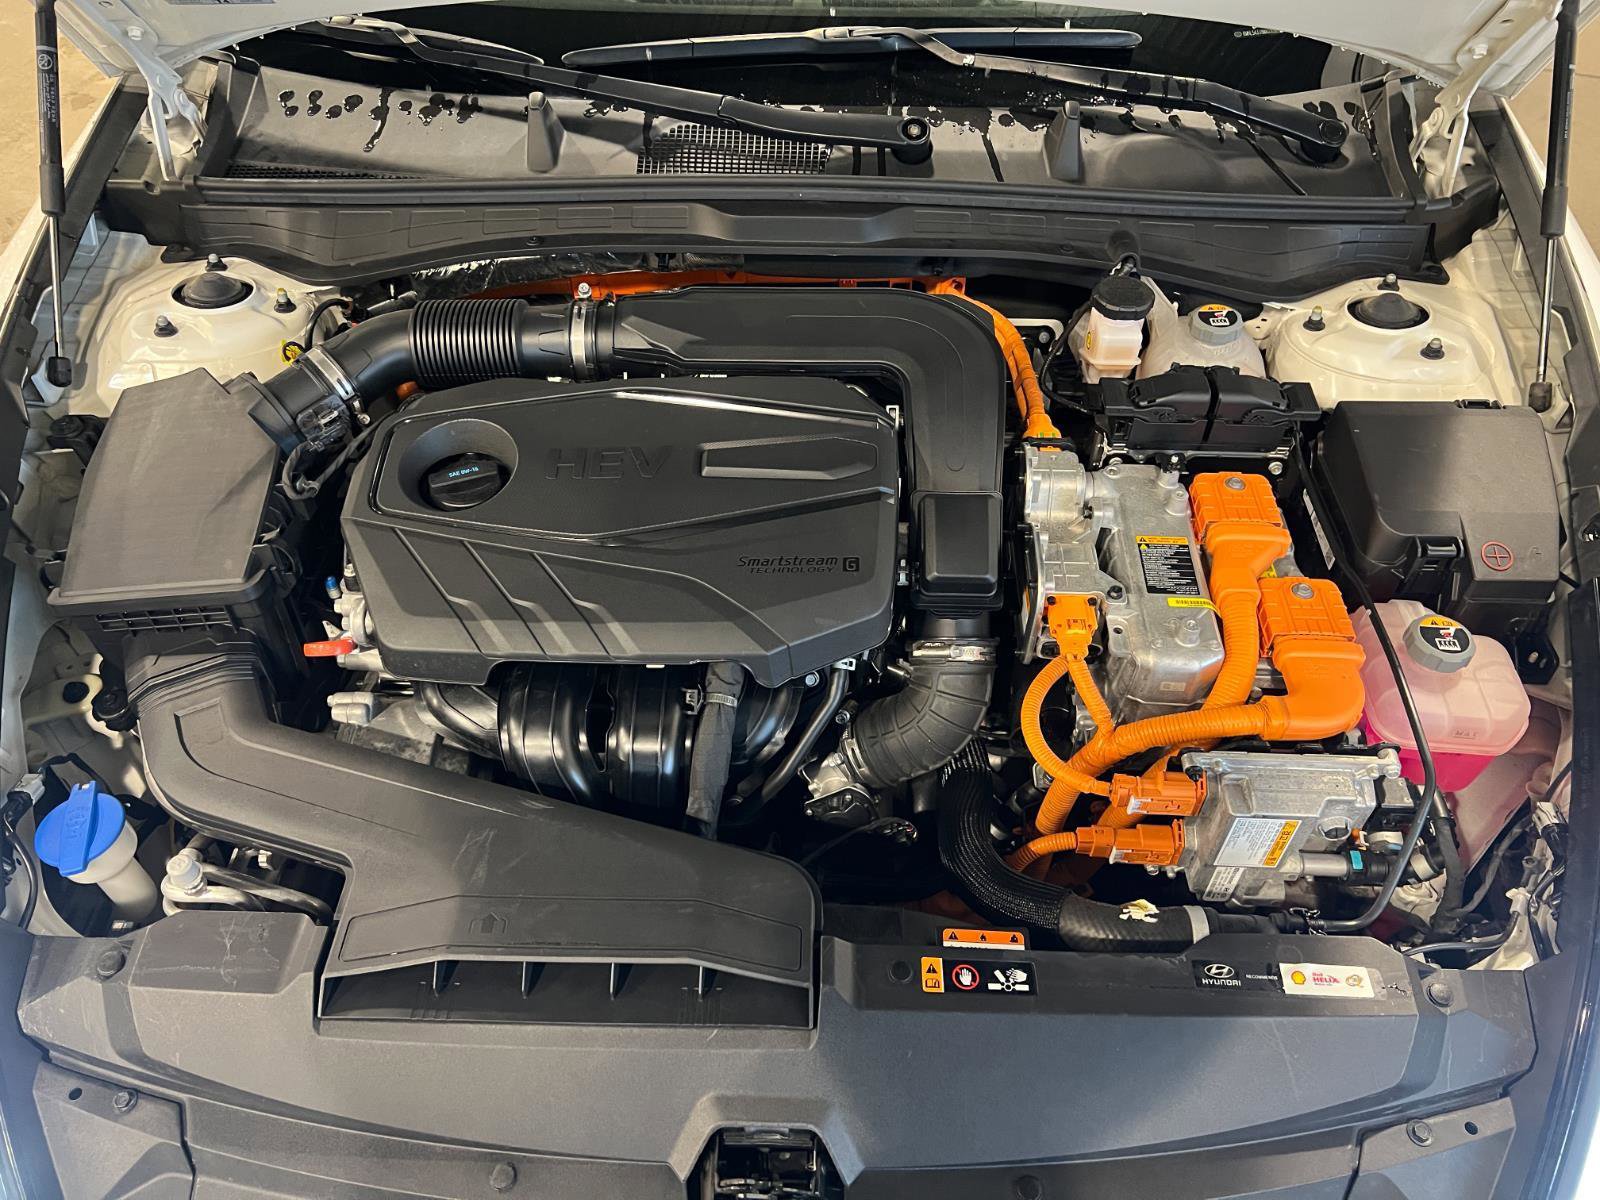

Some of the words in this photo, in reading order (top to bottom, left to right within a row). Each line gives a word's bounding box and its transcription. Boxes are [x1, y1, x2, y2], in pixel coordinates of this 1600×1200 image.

[546, 448, 673, 480] HEV
[737, 555, 839, 567] Smartstream
[843, 557, 859, 572] G
[750, 566, 834, 574] TECHNOLOGY
[1201, 978, 1241, 987] HYUNDAI
[1312, 976, 1341, 984] HELIX
